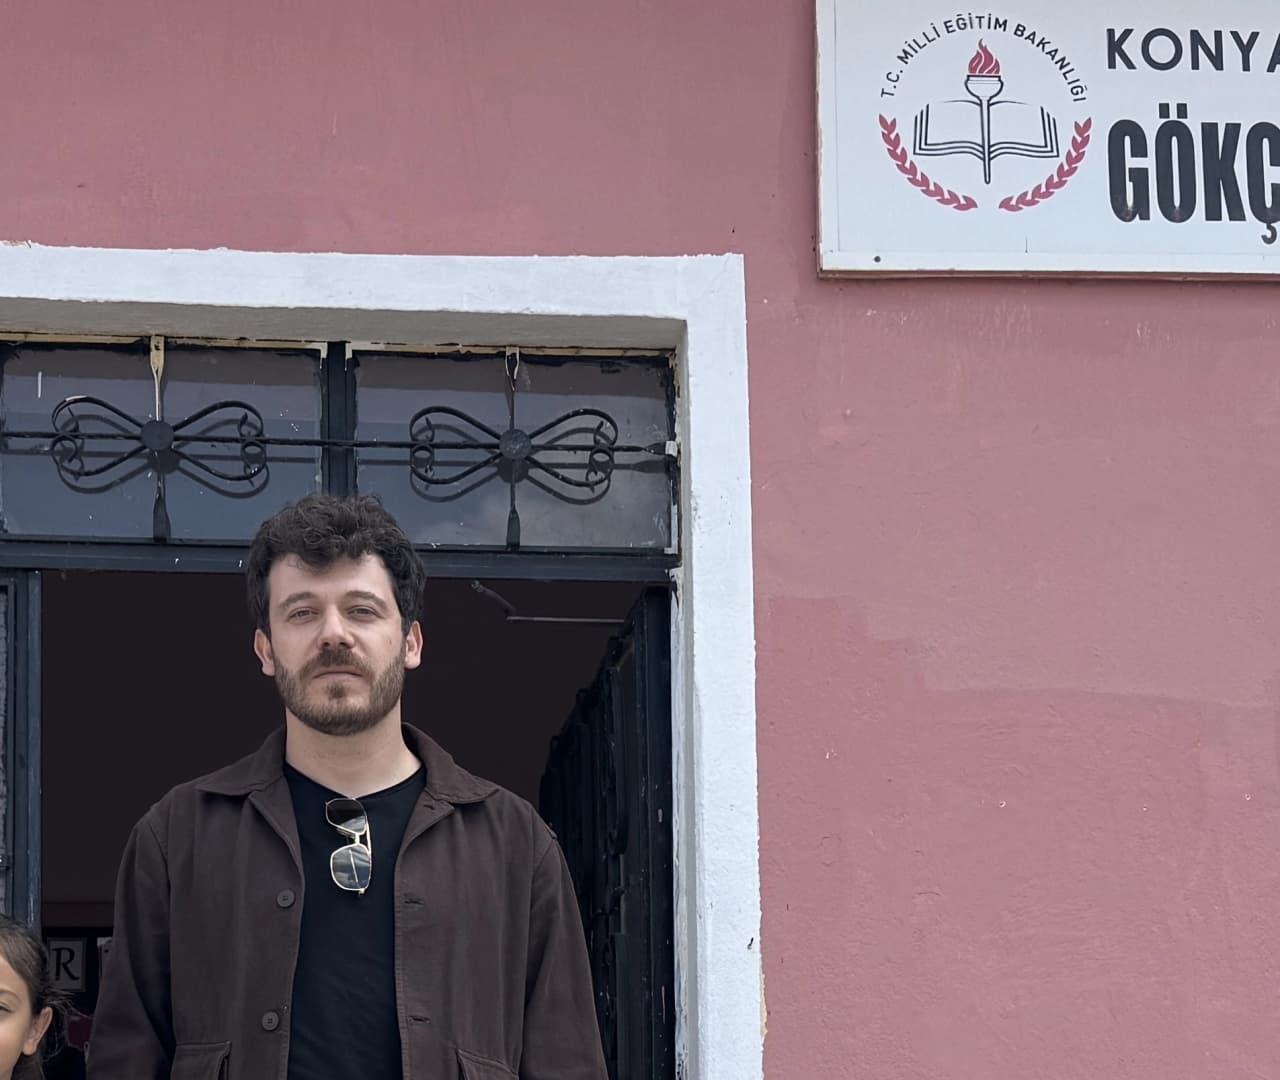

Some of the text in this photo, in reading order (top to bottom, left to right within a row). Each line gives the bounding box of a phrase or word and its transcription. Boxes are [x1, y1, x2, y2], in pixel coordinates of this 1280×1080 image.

[880, 12, 1087, 102] T.C. MİLLİ EĞİTİM BAKANLIĞI
[52, 947, 81, 981] R
